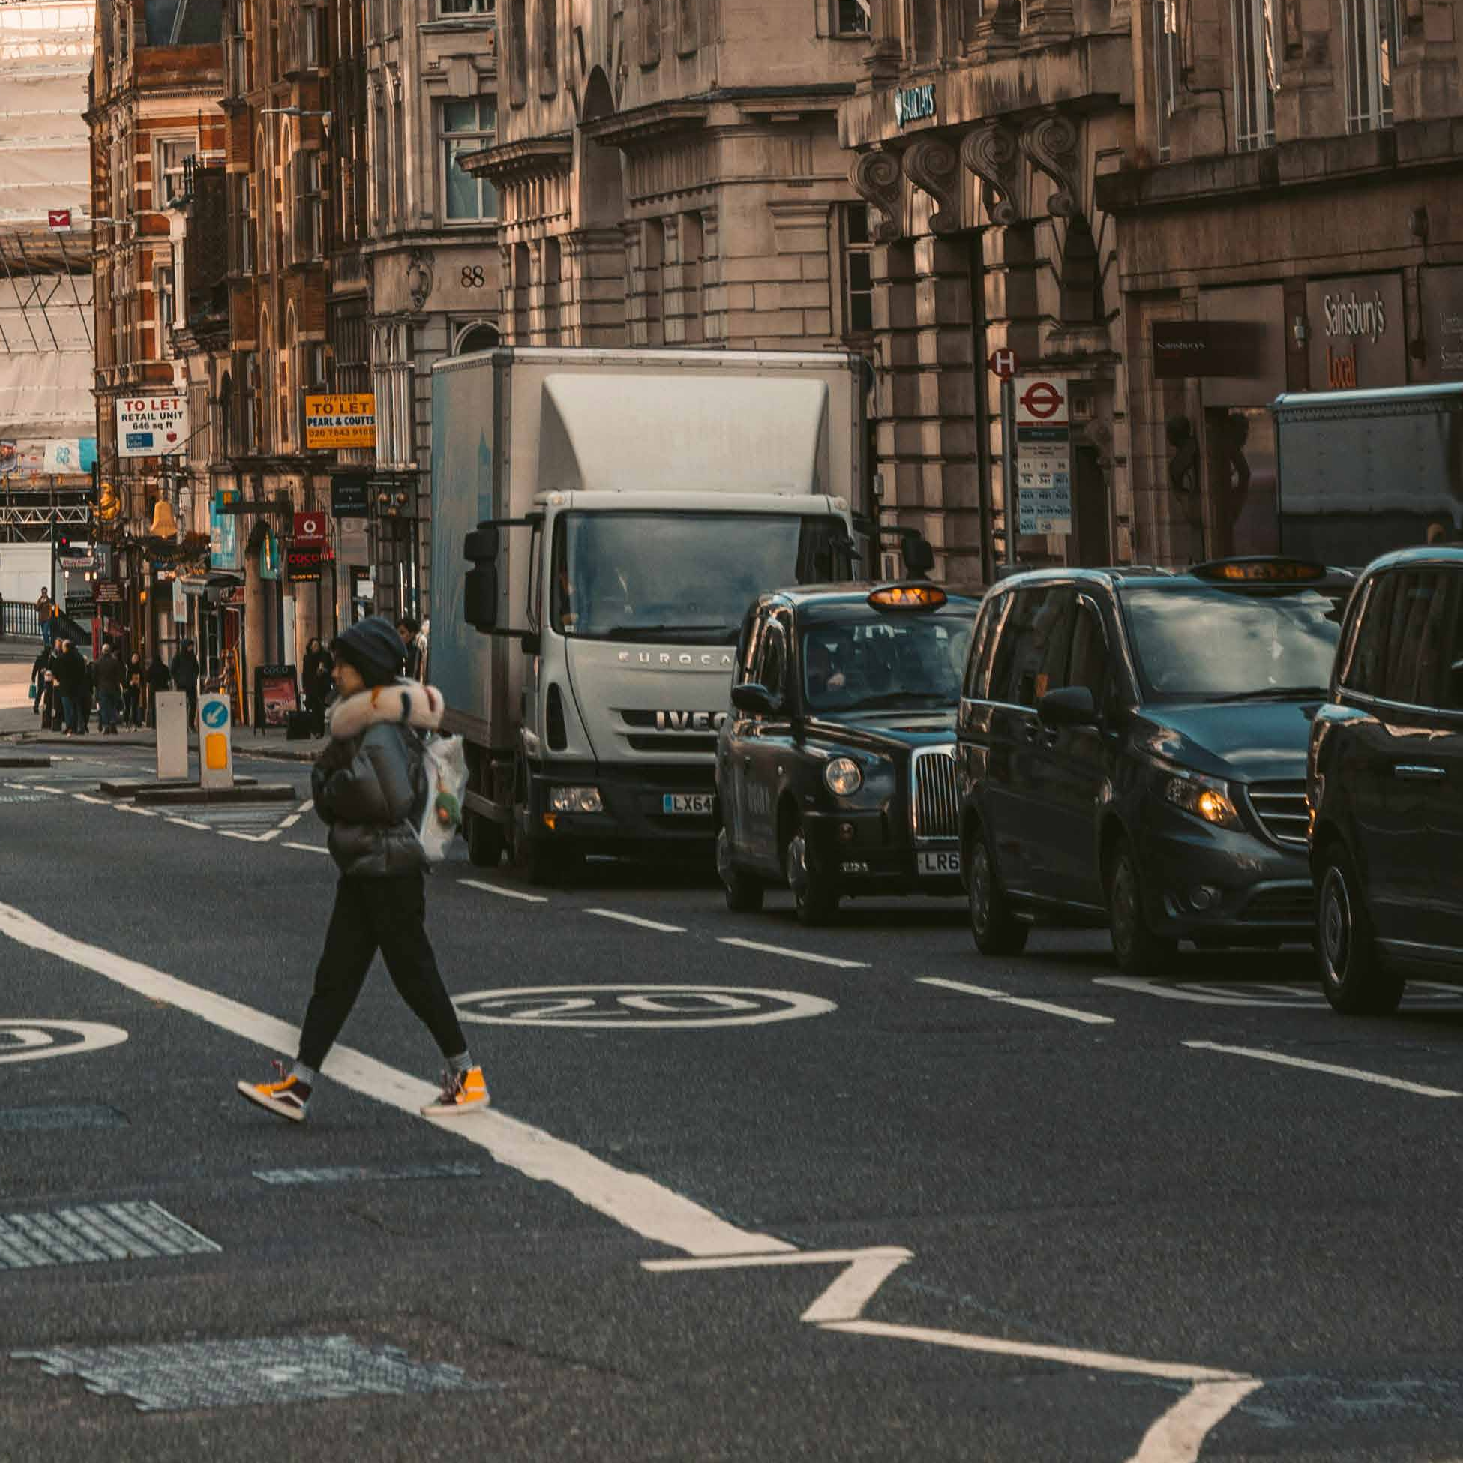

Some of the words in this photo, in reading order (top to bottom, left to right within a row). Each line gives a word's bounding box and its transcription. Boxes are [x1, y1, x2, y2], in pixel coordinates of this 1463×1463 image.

[461, 265, 485, 288] 88
[1324, 290, 1385, 344] Sainsbury's
[996, 351, 1015, 373] H
[1326, 345, 1356, 388] Local
[124, 400, 145, 412] TO
[150, 398, 180, 411] LET
[312, 402, 334, 414] TO
[339, 402, 369, 414] LET
[121, 412, 156, 422] RETAIL
[159, 411, 184, 420] UNIT
[307, 417, 334, 426] PEARL
[335, 416, 342, 425] &
[344, 415, 375, 425] COUTTS
[618, 651, 732, 666] EUROCA
[673, 795, 713, 811] LX64
[925, 853, 959, 872] LR6
